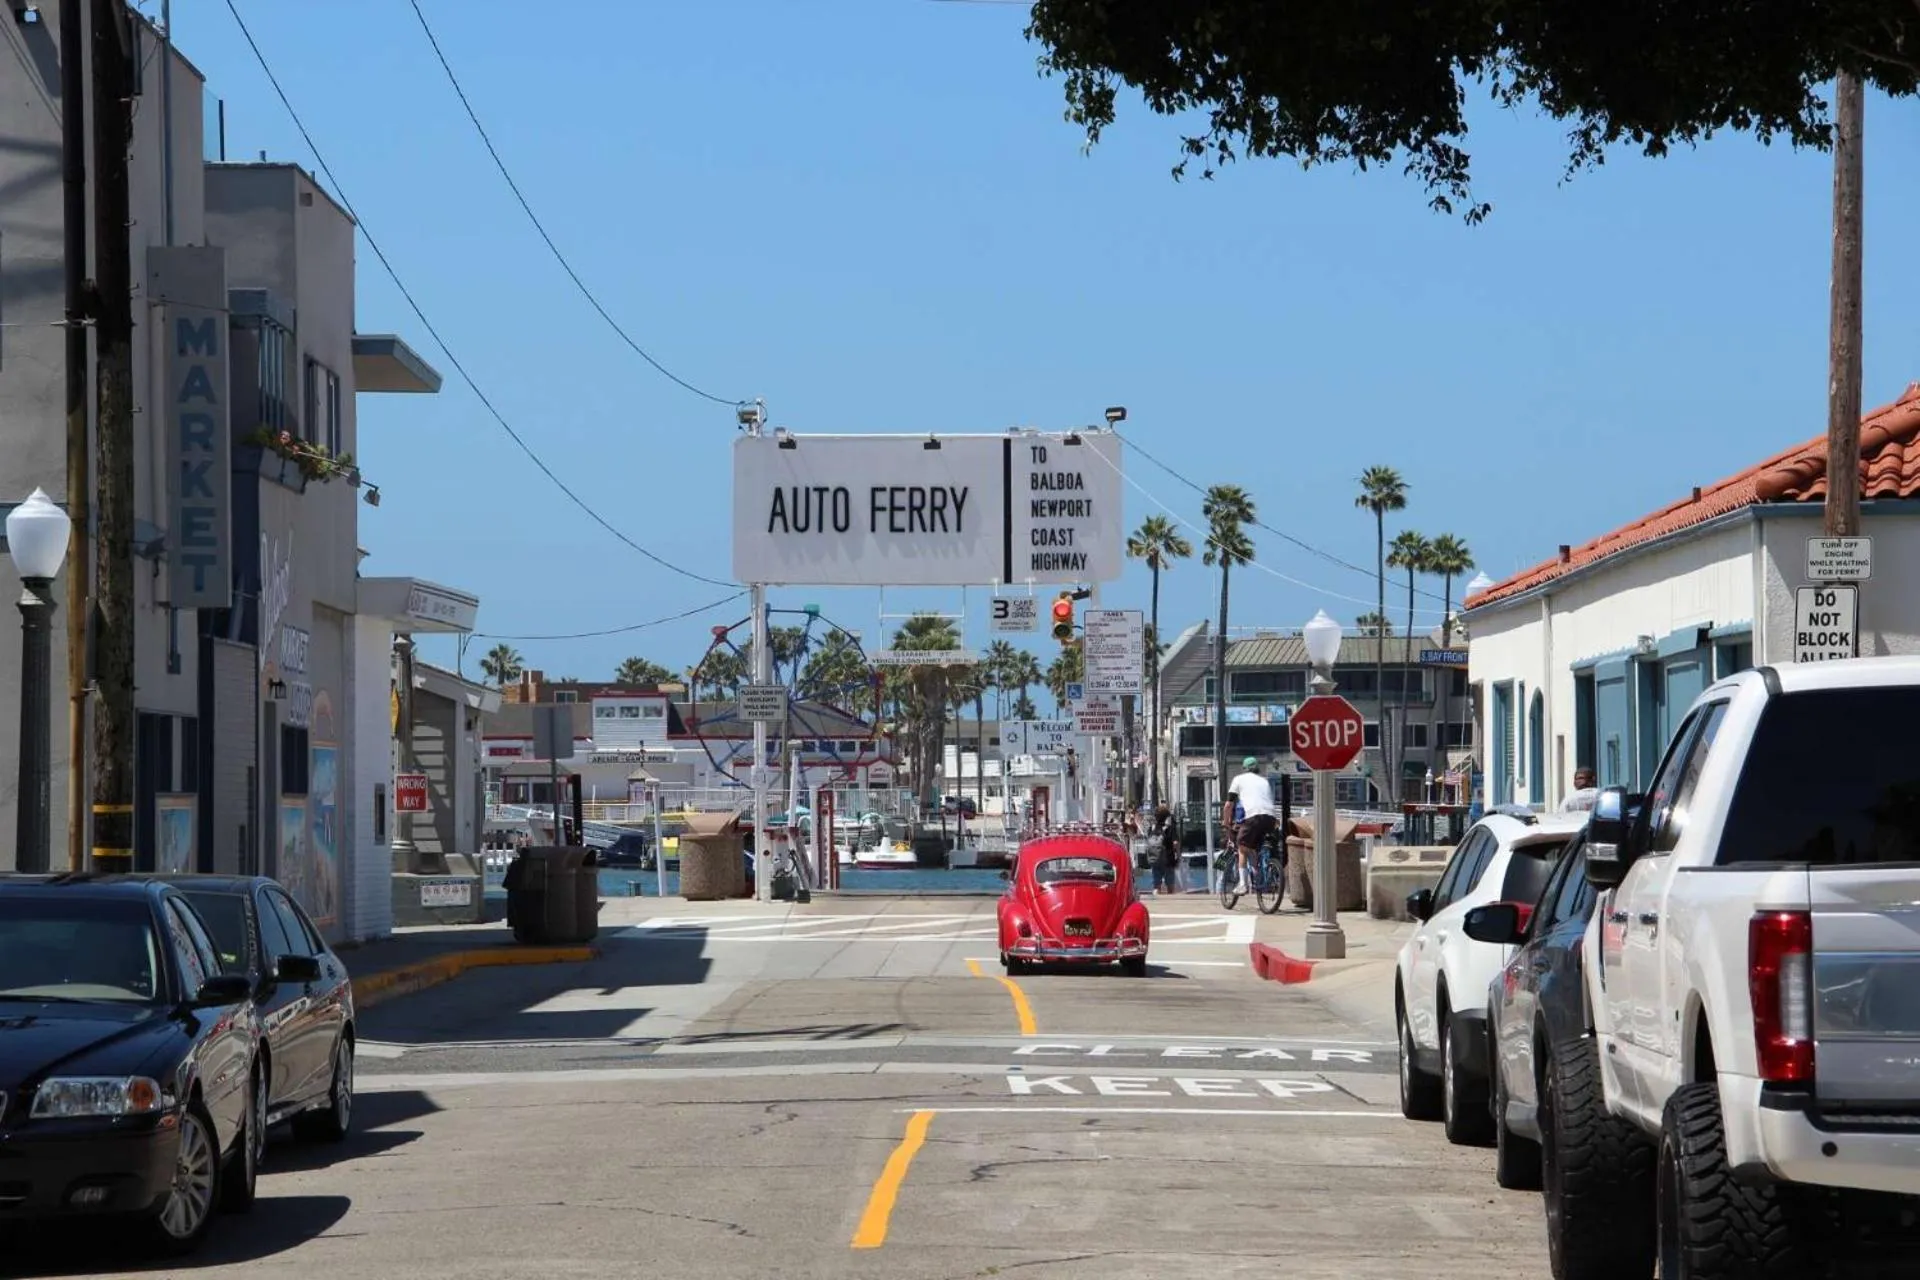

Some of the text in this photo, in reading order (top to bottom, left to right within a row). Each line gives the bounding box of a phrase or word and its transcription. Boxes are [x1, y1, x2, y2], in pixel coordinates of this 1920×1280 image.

[176, 317, 217, 593] MARKET
[1031, 446, 1047, 463] TO
[1031, 472, 1084, 490] BALBOA
[768, 486, 968, 533] AUTO FERRY
[1031, 499, 1092, 518] NEWPORT
[1031, 528, 1074, 546] COAST
[1031, 553, 1087, 571] HIGHWAY
[1815, 593, 1836, 607] DO
[993, 600, 1009, 619] 3
[1809, 612, 1841, 626] NOT
[1798, 632, 1850, 646] BLOCK
[1033, 722, 1073, 732] WELCOM
[1295, 719, 1358, 749] STOP
[1050, 733, 1062, 741] TO
[397, 778, 428, 789] WRONG
[402, 796, 420, 808] WAY
[1011, 1044, 1374, 1064] CLEAR
[1006, 1075, 1335, 1098] KEEP
